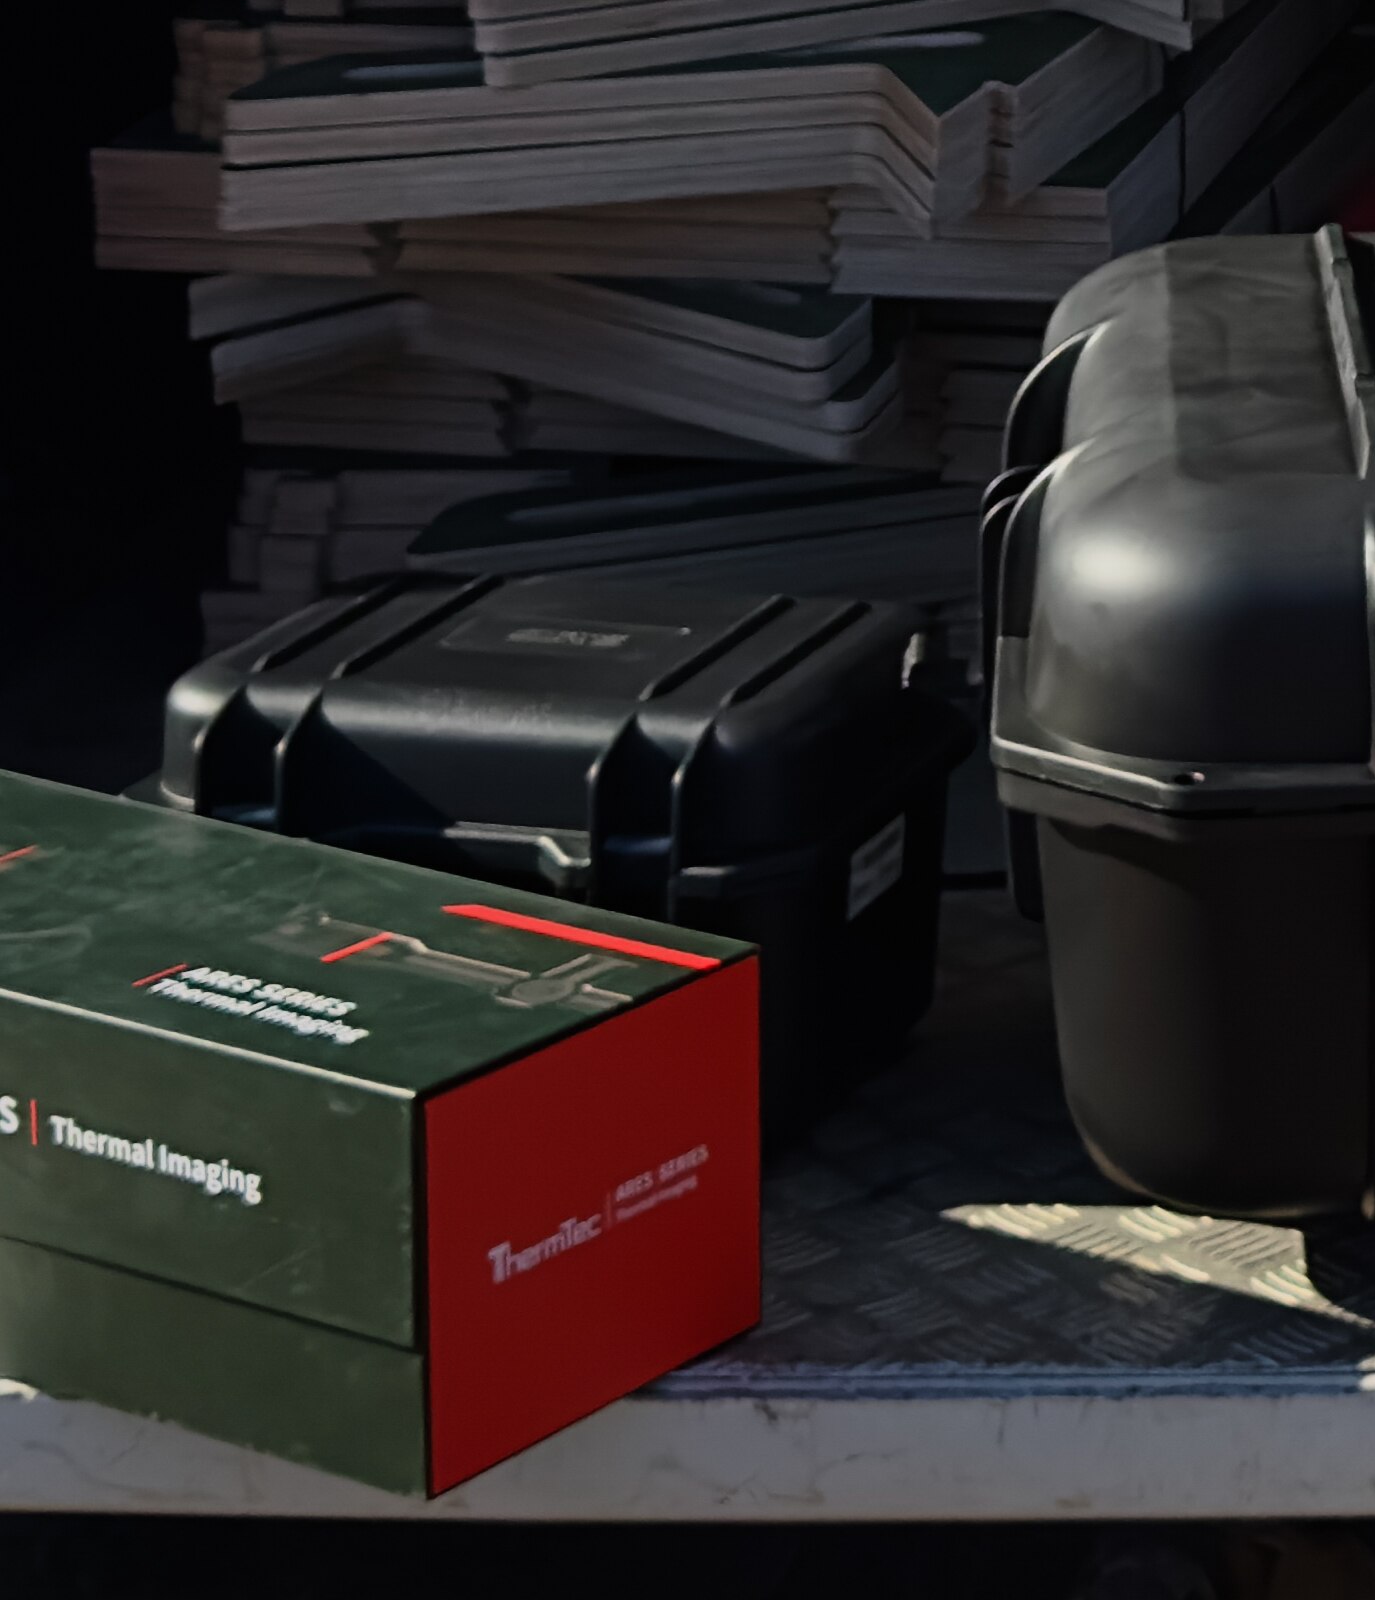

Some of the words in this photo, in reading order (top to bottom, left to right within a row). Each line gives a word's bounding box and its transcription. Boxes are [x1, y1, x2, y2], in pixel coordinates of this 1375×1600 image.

[147, 977, 268, 1016] Thermal
[252, 1004, 371, 1046] Imaging
[250, 983, 358, 1017] SERIES
[49, 1114, 155, 1170] Thermal
[157, 1143, 263, 1207] Imaging
[486, 1213, 603, 1285] ThermTec
